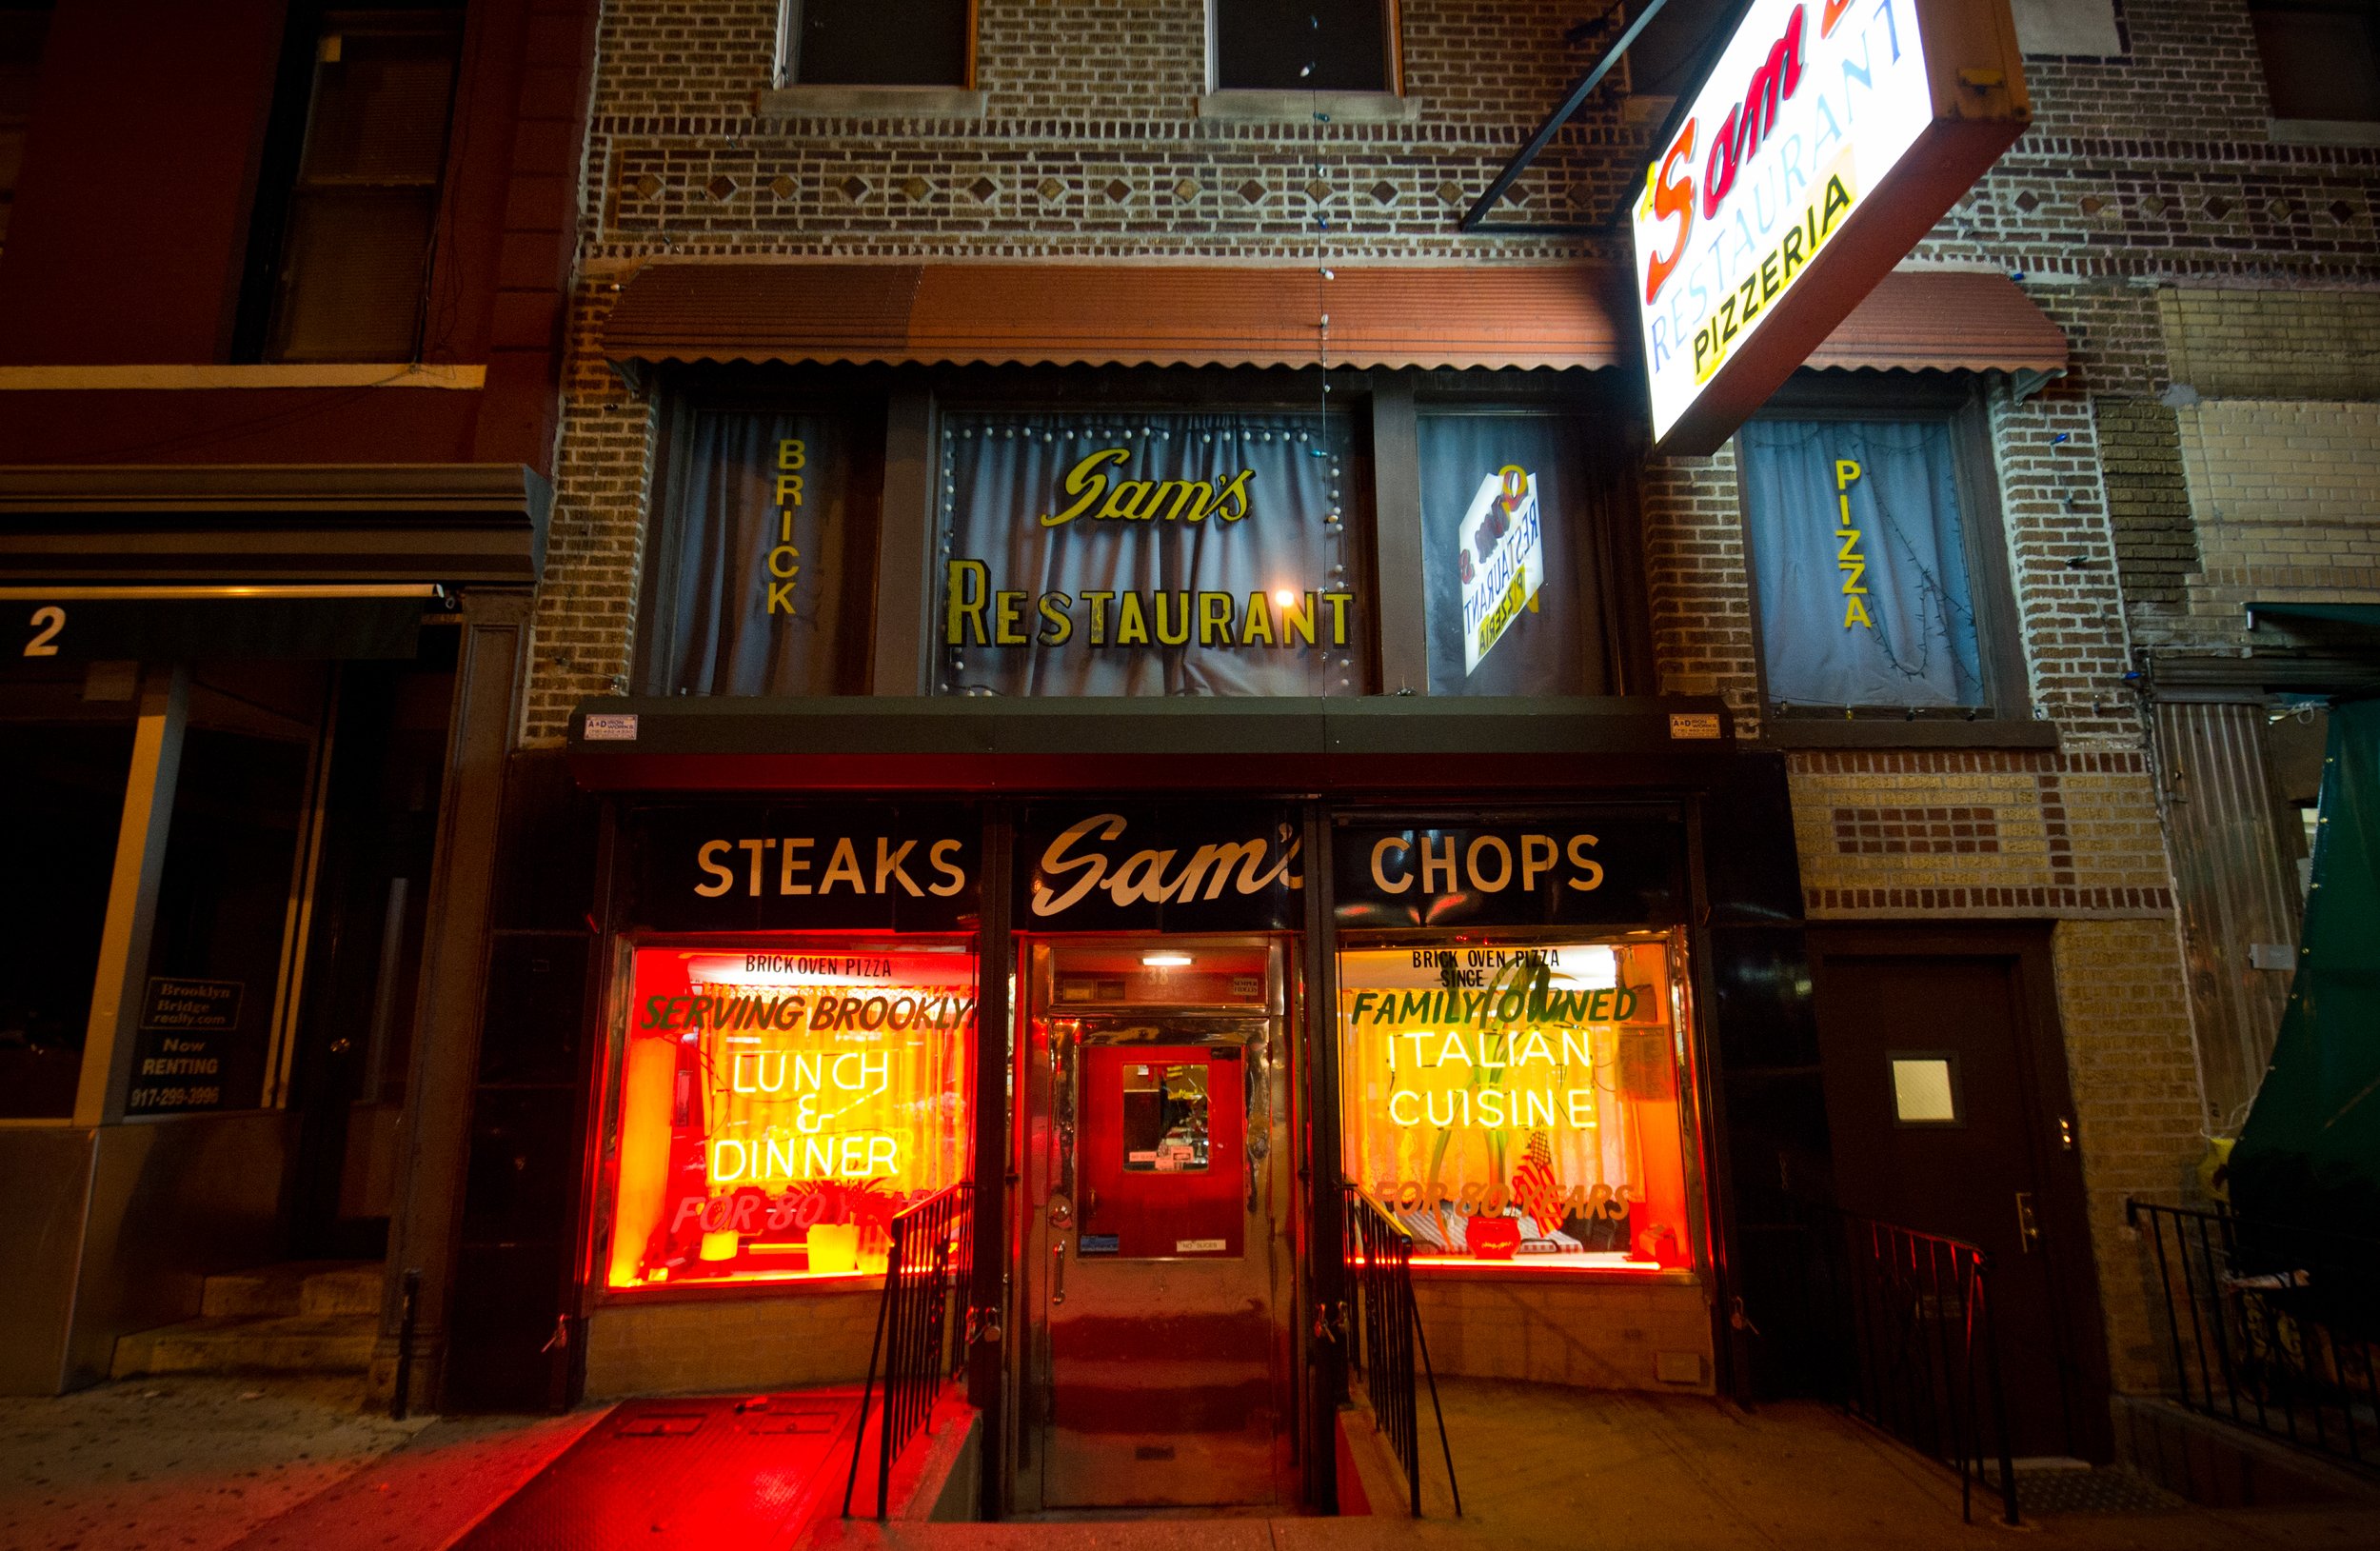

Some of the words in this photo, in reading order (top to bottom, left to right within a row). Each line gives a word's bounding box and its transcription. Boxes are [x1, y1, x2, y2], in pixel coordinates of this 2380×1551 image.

[1646, 0, 1853, 306] Sam
[1651, 0, 1902, 374] RESTAURANT
[1693, 172, 1851, 376] PIZZERIA
[1041, 447, 1257, 527] Sam's
[766, 439, 806, 614] BRICK
[1835, 459, 1873, 628] PIZZA
[23, 606, 66, 657] 2
[693, 836, 965, 897] STEAKS
[1371, 834, 1605, 894] CHOPS
[745, 954, 794, 973] BRICK
[798, 956, 838, 975] OVEN
[845, 958, 892, 977] PIZZA
[1413, 950, 1458, 968] BRICK
[1468, 949, 1506, 968] OVEN
[1516, 949, 1560, 968] PIZZA
[1440, 969, 1485, 987] SINCE
[156, 999, 210, 1014] Bridge
[160, 983, 231, 1000] Brooklyn
[1350, 992, 1487, 1025] FAMILY
[1497, 986, 1637, 1024] OWNED
[639, 995, 805, 1031] SERVING
[163, 1037, 206, 1052] Now
[1388, 1030, 1592, 1068] ITALIAN
[142, 1058, 220, 1076] RENTING
[733, 1050, 889, 1093] LUNCH
[797, 1093, 835, 1133] &
[1389, 1088, 1597, 1128] CUISINE
[713, 1136, 900, 1182] DINNER
[670, 1193, 762, 1234] FOR
[766, 1191, 828, 1231] 80
[1374, 1182, 1448, 1216] FOR
[1455, 1183, 1511, 1219] 80
[1519, 1183, 1635, 1220] YEARS
